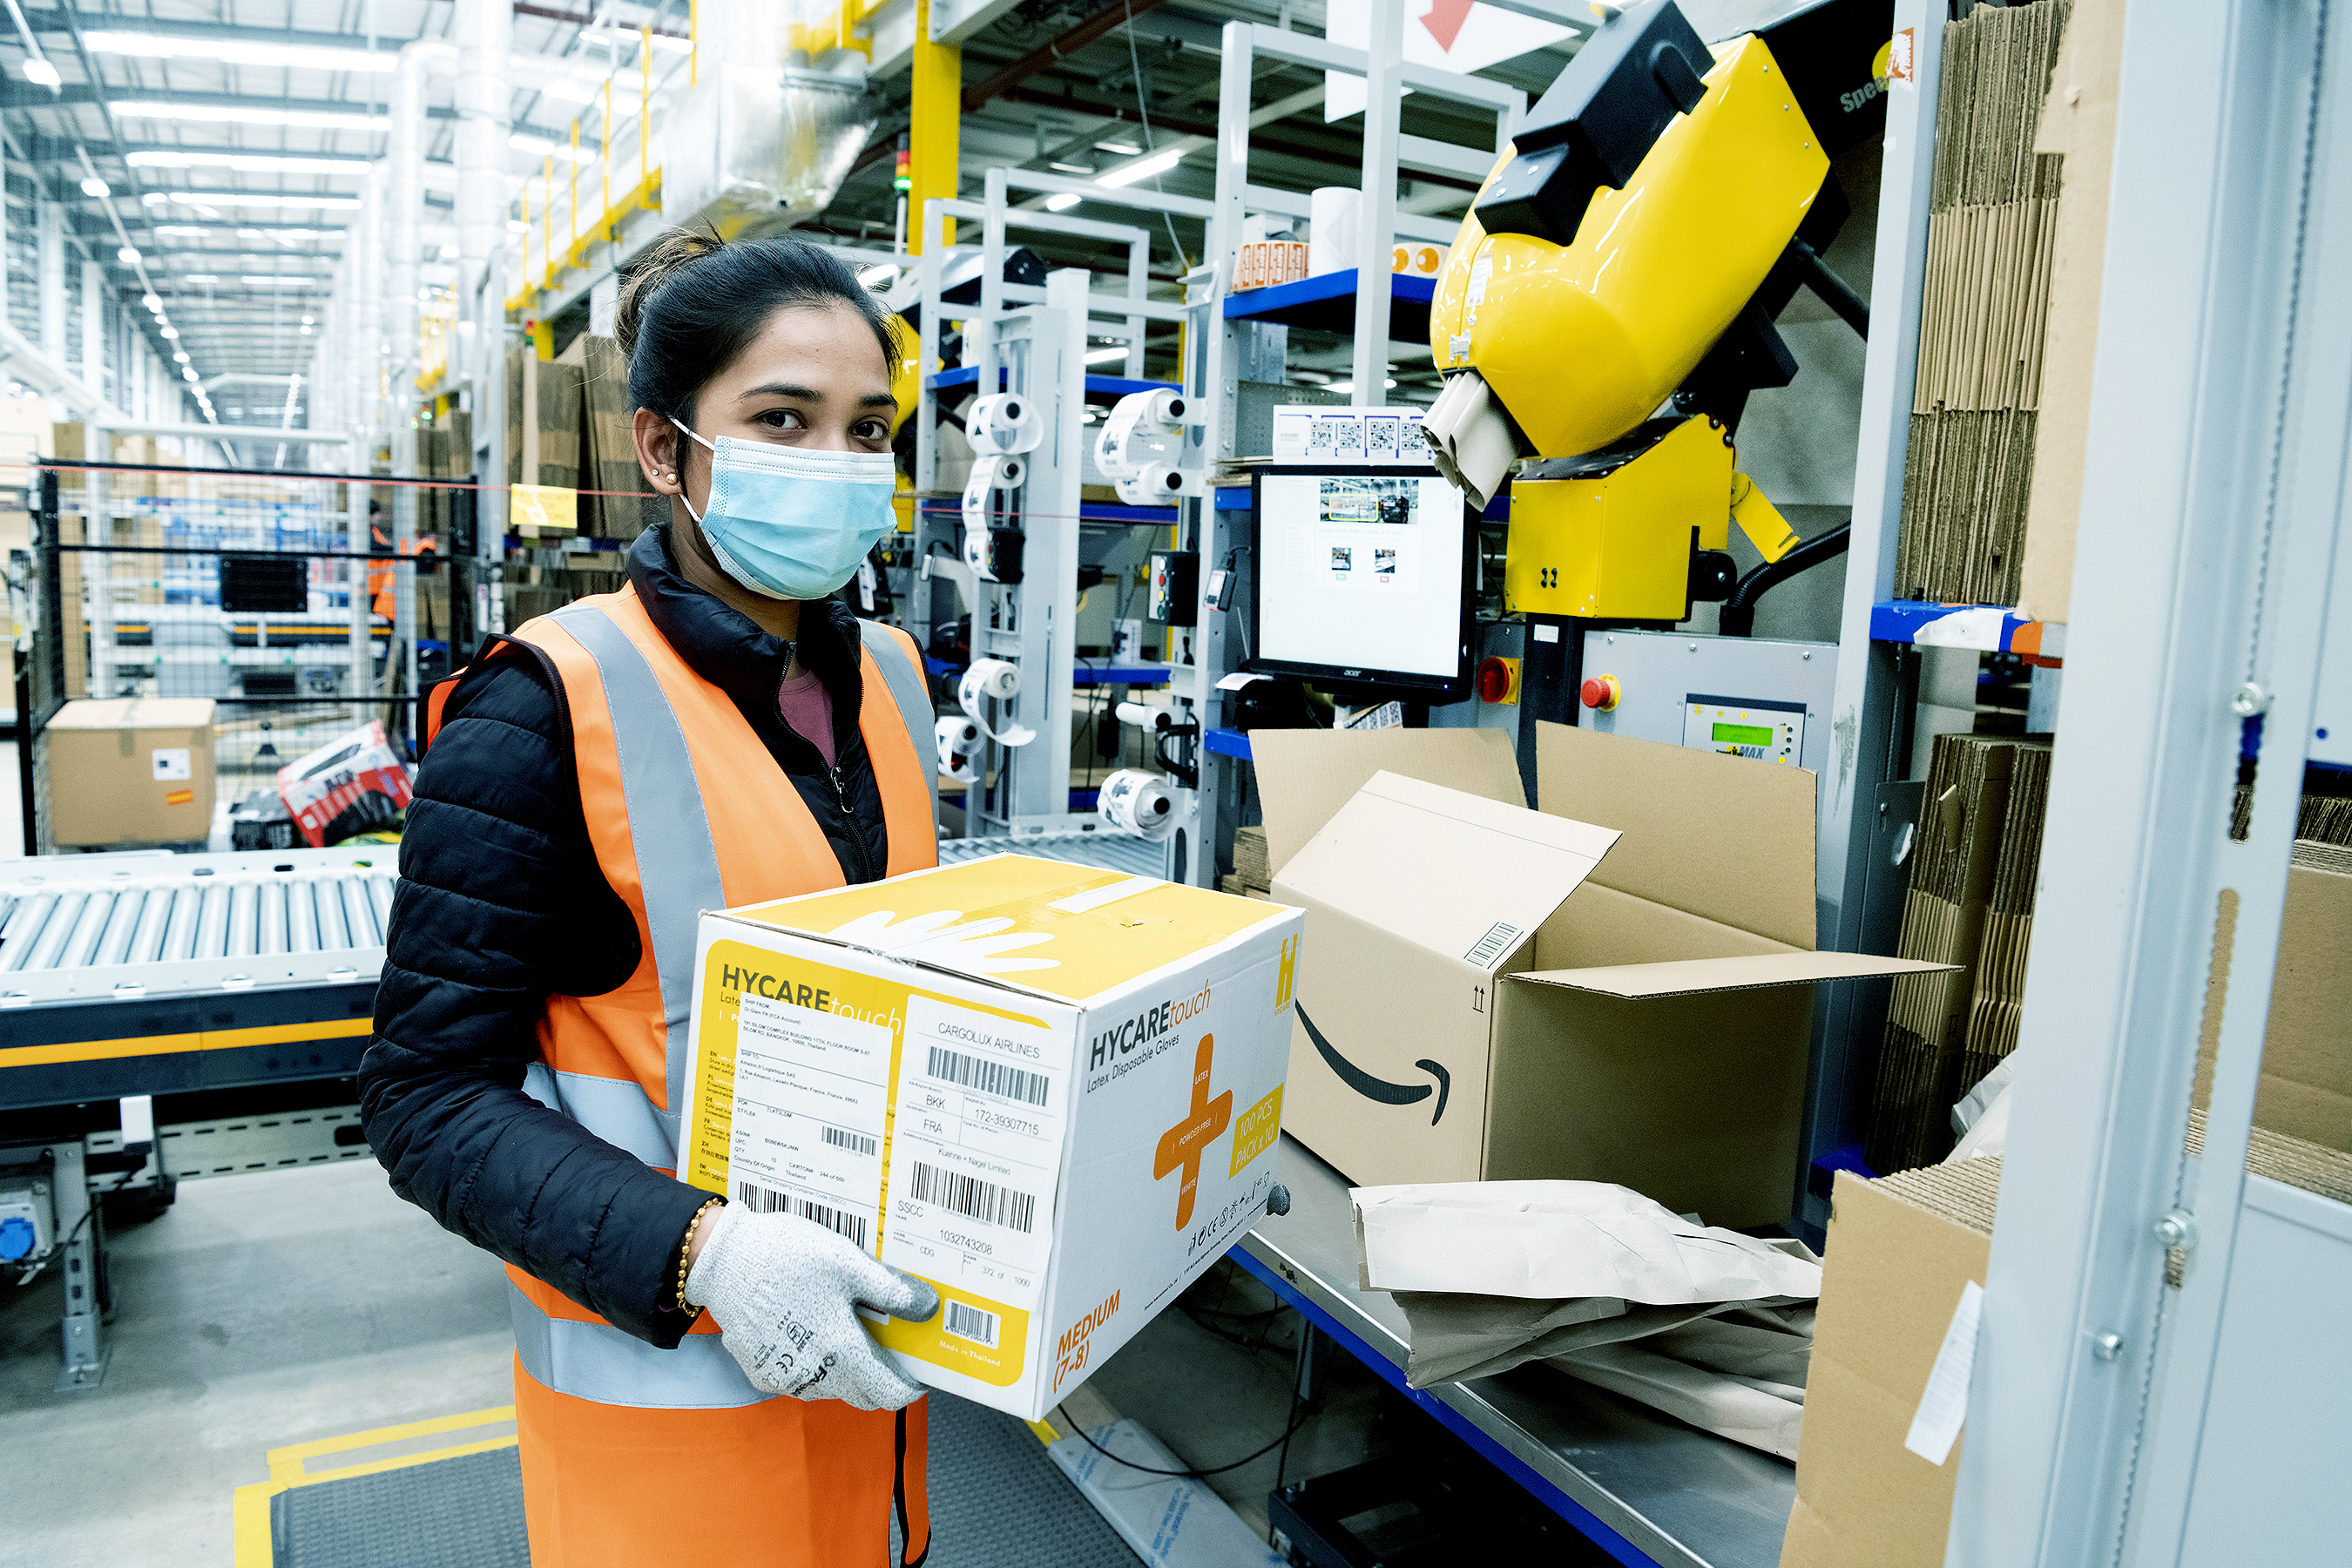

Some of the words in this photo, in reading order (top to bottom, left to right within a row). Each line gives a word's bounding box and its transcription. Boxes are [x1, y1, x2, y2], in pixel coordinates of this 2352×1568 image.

[1840, 76, 1889, 113] Spee
[720, 991, 740, 1007] Late
[808, 1042, 827, 1051] Thailand
[937, 1022, 993, 1047] CARGOLUX
[994, 1037, 1041, 1059] AIRLINES
[1086, 1073, 1111, 1094] Latex
[1112, 1047, 1153, 1080] Disposable
[1155, 1034, 1179, 1055] Gloves
[1194, 1069, 1209, 1085] LATEX
[926, 1094, 946, 1110] BKK
[923, 1119, 943, 1134] FRA
[975, 1108, 1039, 1136] 172-39307715
[1240, 1112, 1255, 1139] 100
[1257, 1098, 1273, 1125] PCS
[1179, 1117, 1212, 1147] POWDER-FREE
[1236, 1136, 1259, 1170] PACK
[1265, 1123, 1274, 1145] 10
[786, 1170, 807, 1180] Thailand
[969, 1157, 986, 1169] Nagel
[988, 1162, 1010, 1175] Limited
[1181, 1177, 1197, 1195] WHITE
[897, 1200, 924, 1218] SSCC
[919, 1246, 935, 1257] CDG
[939, 1229, 993, 1255] 1032743208
[983, 1266, 994, 1276] 372
[1014, 1276, 1031, 1288] 1000
[1056, 1288, 1121, 1362] MEDIUM
[939, 1340, 959, 1353] Made
[970, 1350, 1001, 1367] Thailand
[1053, 1339, 1090, 1395] (7-8)
